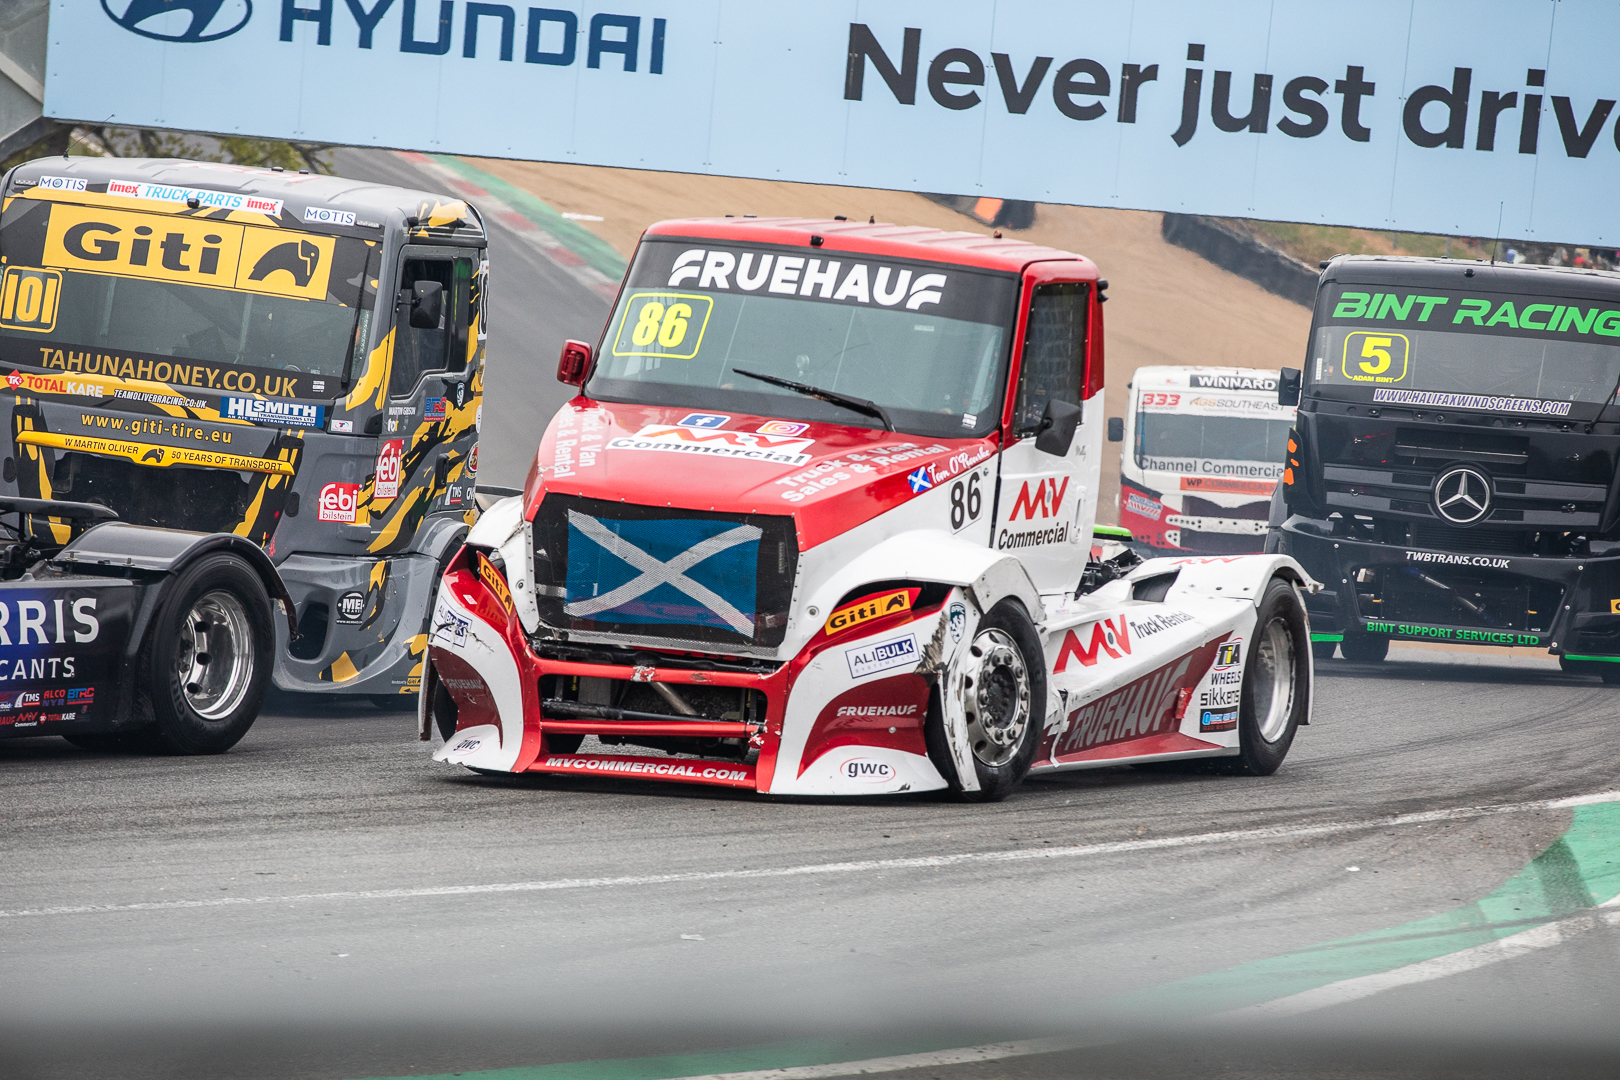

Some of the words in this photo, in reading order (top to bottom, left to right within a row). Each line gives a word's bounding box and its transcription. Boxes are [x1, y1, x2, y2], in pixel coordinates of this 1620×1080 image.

[278, 0, 667, 75] HYUNDAI
[843, 22, 1160, 124] Never
[1171, 42, 1376, 149] just
[1402, 66, 1620, 159] driv
[39, 177, 86, 191] MOTIS
[109, 181, 140, 197] imex
[144, 185, 194, 201] TRUCK
[195, 192, 243, 208] PARTS
[246, 197, 278, 212] imex
[306, 209, 355, 225] MOTIS
[63, 221, 223, 275] Giti
[667, 249, 948, 311] FRUEHAUF
[1, 273, 59, 325] 101
[631, 301, 693, 348] 86
[1332, 291, 1450, 322] BINT
[1451, 298, 1620, 338] RACING
[1358, 336, 1393, 375] 5
[39, 347, 298, 398] TAHUNAHONEY.CO.UK
[1197, 375, 1278, 391] WINNARD
[1352, 374, 1375, 383] ADAM
[1375, 376, 1395, 384] BINT
[113, 388, 208, 409] TEAMOLIVERRACING.CO.UK
[425, 396, 447, 413] BTRC
[1141, 392, 1181, 406] 333
[1373, 388, 1572, 416] WWW.HALIFAXWINDSCREENS.COM
[80, 413, 233, 445] www.giti-tire.eu
[260, 412, 303, 422] TRANSMISSIONS
[64, 438, 74, 447] W
[74, 439, 107, 451] MARTIN
[108, 443, 140, 455] OLIVER
[611, 438, 806, 465] Commercial
[171, 450, 182, 460] 50
[183, 452, 213, 463] YEARS
[214, 455, 227, 465] OF
[229, 457, 283, 472] TRANSPORT
[376, 442, 402, 481] febi
[775, 459, 850, 488] Truck
[846, 451, 870, 462] &
[872, 441, 921, 456] Van
[780, 470, 852, 503] Sales
[849, 461, 878, 475] &
[870, 443, 952, 467] Rental
[927, 462, 951, 485] Tom
[1141, 457, 1198, 473] Channel
[377, 484, 397, 497] bilstein
[1186, 477, 1203, 487] WP
[1203, 478, 1276, 491] COMMERCIALS
[318, 483, 359, 512] febi
[950, 470, 982, 531] 86
[1008, 475, 1071, 522] MV
[322, 510, 352, 521] bilstein
[998, 520, 1070, 551] Commercial
[1405, 551, 1511, 569] TWBTRANS.CO.UK
[483, 564, 504, 597] Giti
[830, 603, 877, 630] Giti
[1130, 615, 1163, 640] Truck
[1160, 610, 1196, 630] Rental
[1052, 613, 1132, 675] MV
[1366, 621, 1396, 634] BINT
[1398, 624, 1454, 639] SUPPORT
[1455, 629, 1515, 644] SERVICES
[1517, 634, 1540, 645] LTD
[853, 638, 914, 667] ALIBULK
[1210, 670, 1242, 686] WHEELS
[25, 692, 40, 702] TMS
[42, 698, 65, 707] NYR
[43, 689, 66, 699] ALCO
[67, 687, 95, 700] BTRC
[1063, 654, 1194, 752] FRUEHAUF
[47, 712, 77, 721] TOTALKARE
[836, 704, 918, 717] FRUEHAUF
[544, 756, 748, 782] MVCOMMERCIAL.COM
[847, 762, 890, 778] gwc
